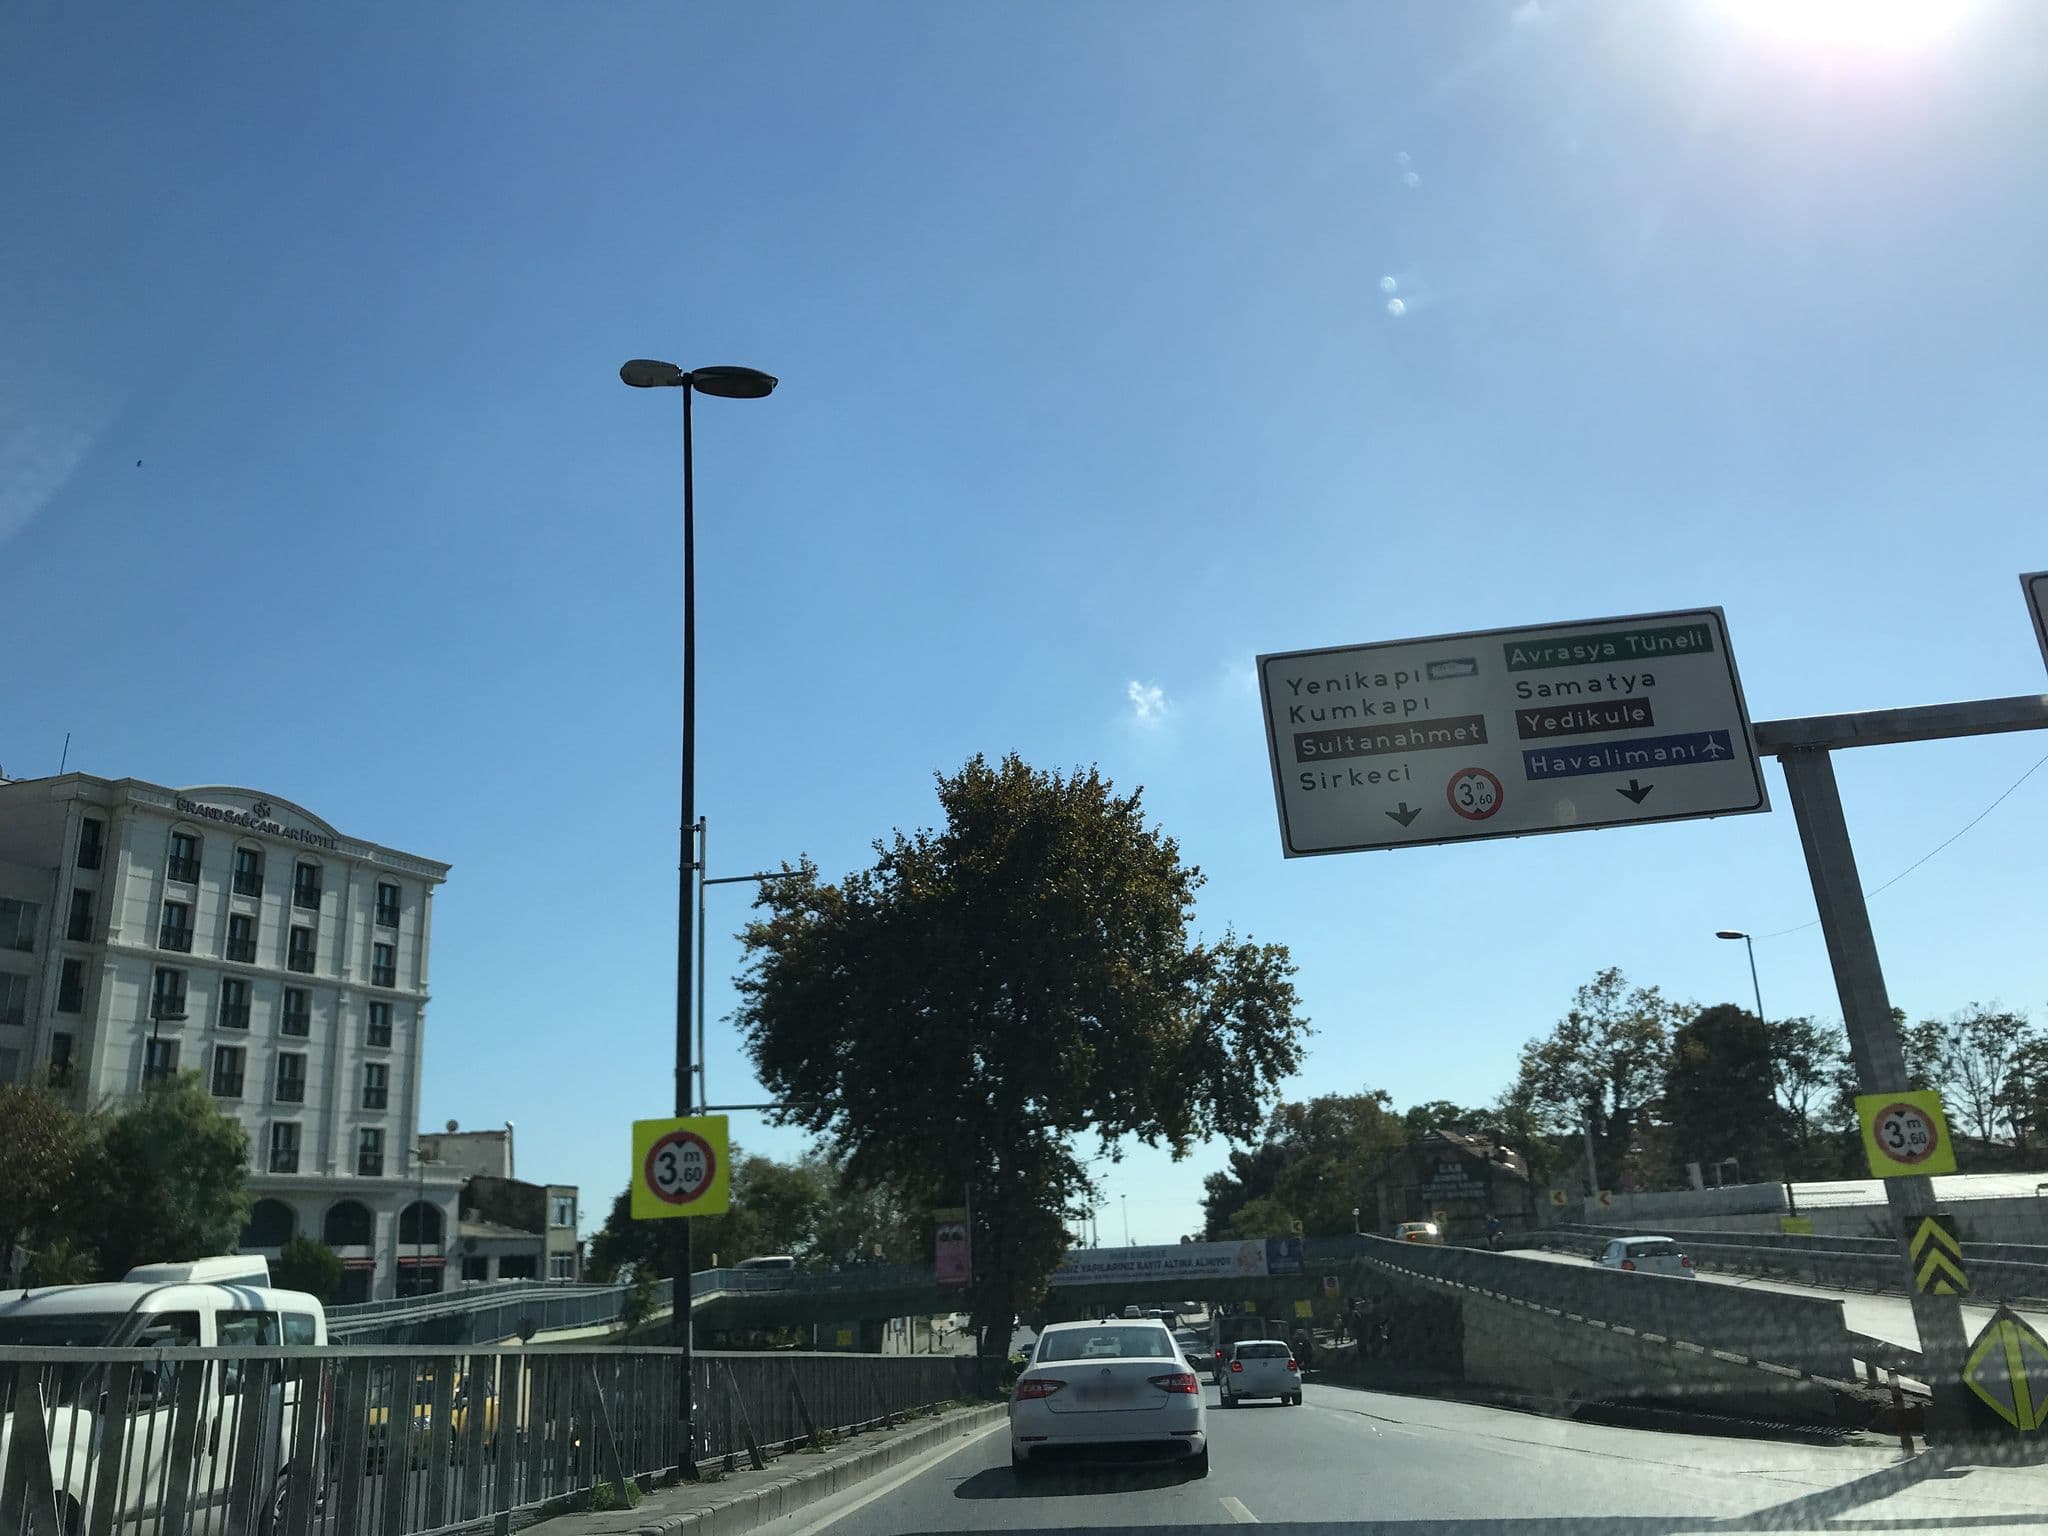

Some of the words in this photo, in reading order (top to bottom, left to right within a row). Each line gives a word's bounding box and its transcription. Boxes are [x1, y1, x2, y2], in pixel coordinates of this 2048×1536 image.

[1511, 641, 1617, 665] Avrasya
[1625, 630, 1704, 654] Tüneli
[1286, 669, 1421, 697] Yenikapı
[1515, 672, 1657, 700] Samatya
[1288, 697, 1431, 725] Kumkapı
[1524, 705, 1646, 732] Yedikule
[1301, 722, 1480, 757] Sultanahmet
[1531, 744, 1697, 774] Havalimanı
[1299, 763, 1411, 791] Sirkeci
[176, 799, 223, 821] GRAND
[300, 828, 338, 850] HOTEL
